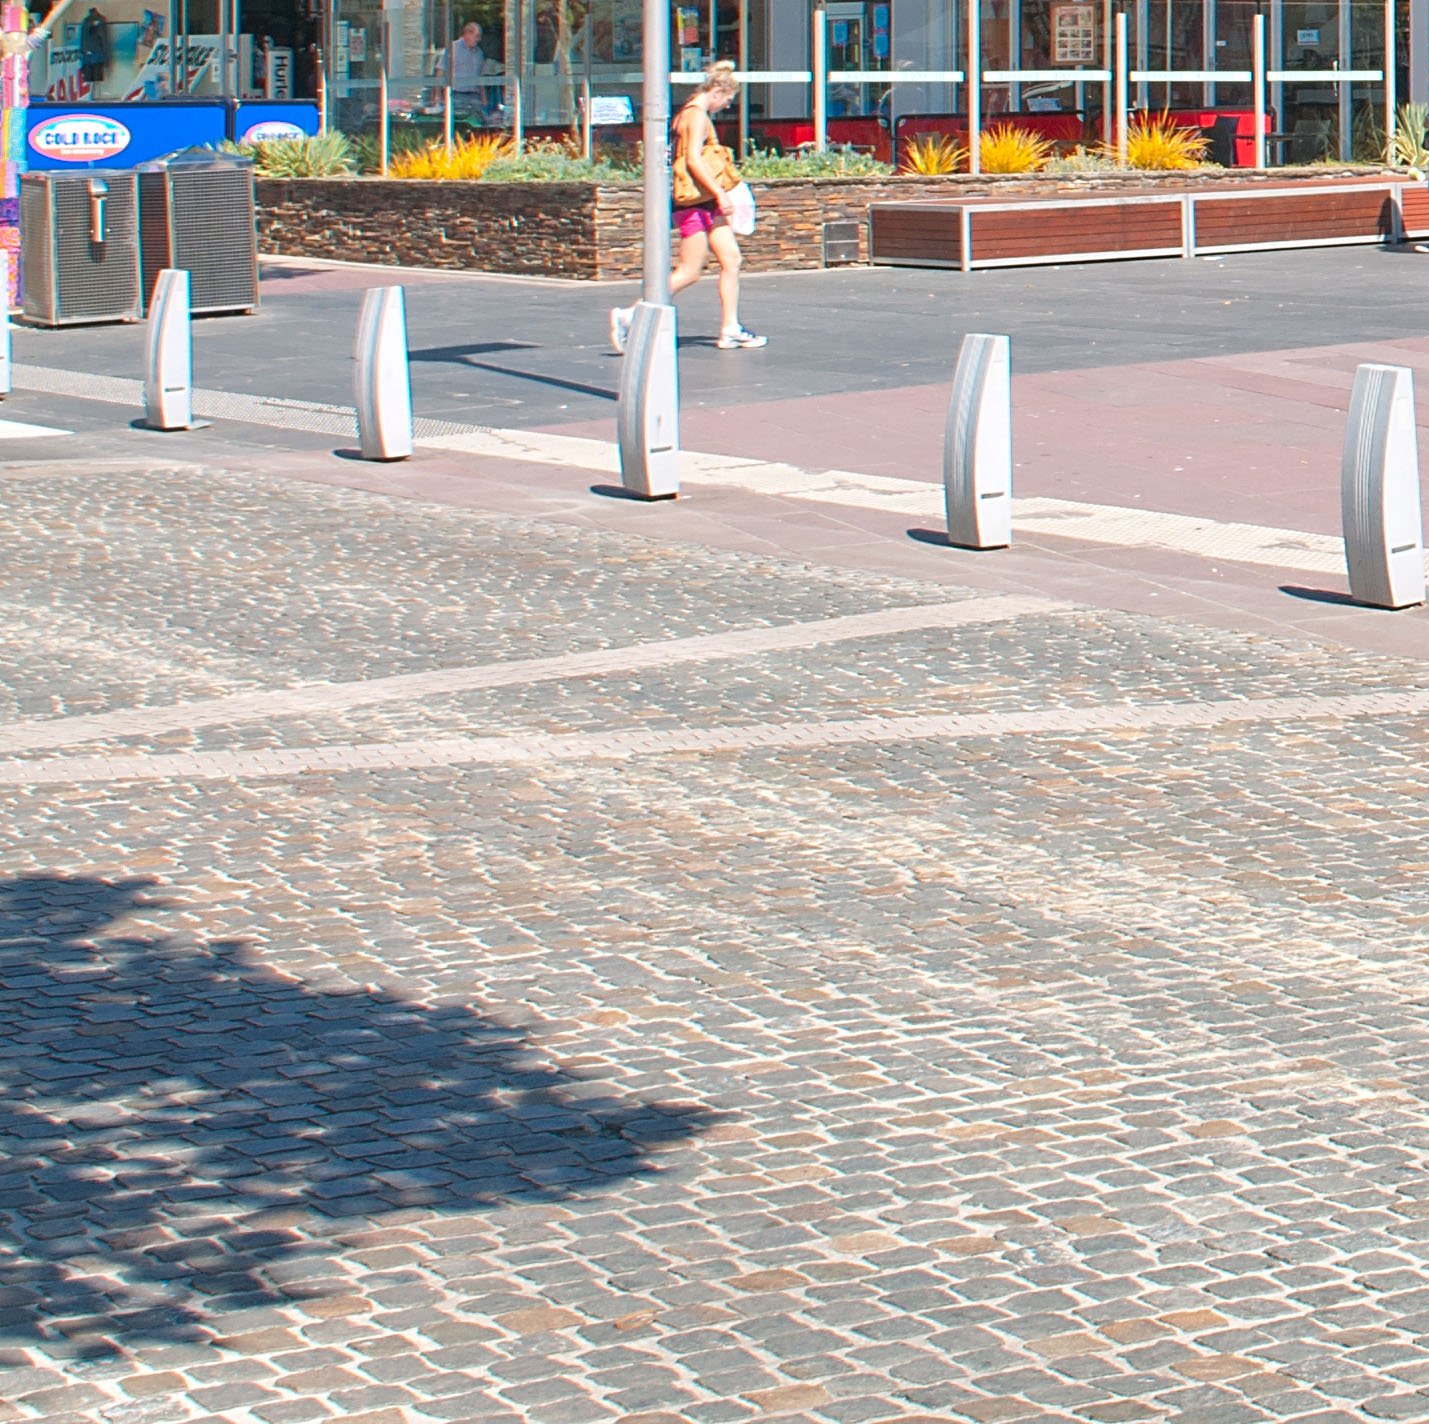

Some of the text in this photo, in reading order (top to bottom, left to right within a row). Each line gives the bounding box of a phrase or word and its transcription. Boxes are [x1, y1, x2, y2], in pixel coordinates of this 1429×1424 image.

[274, 55, 289, 99] Hurle
[45, 132, 119, 146] COLD ROCK
